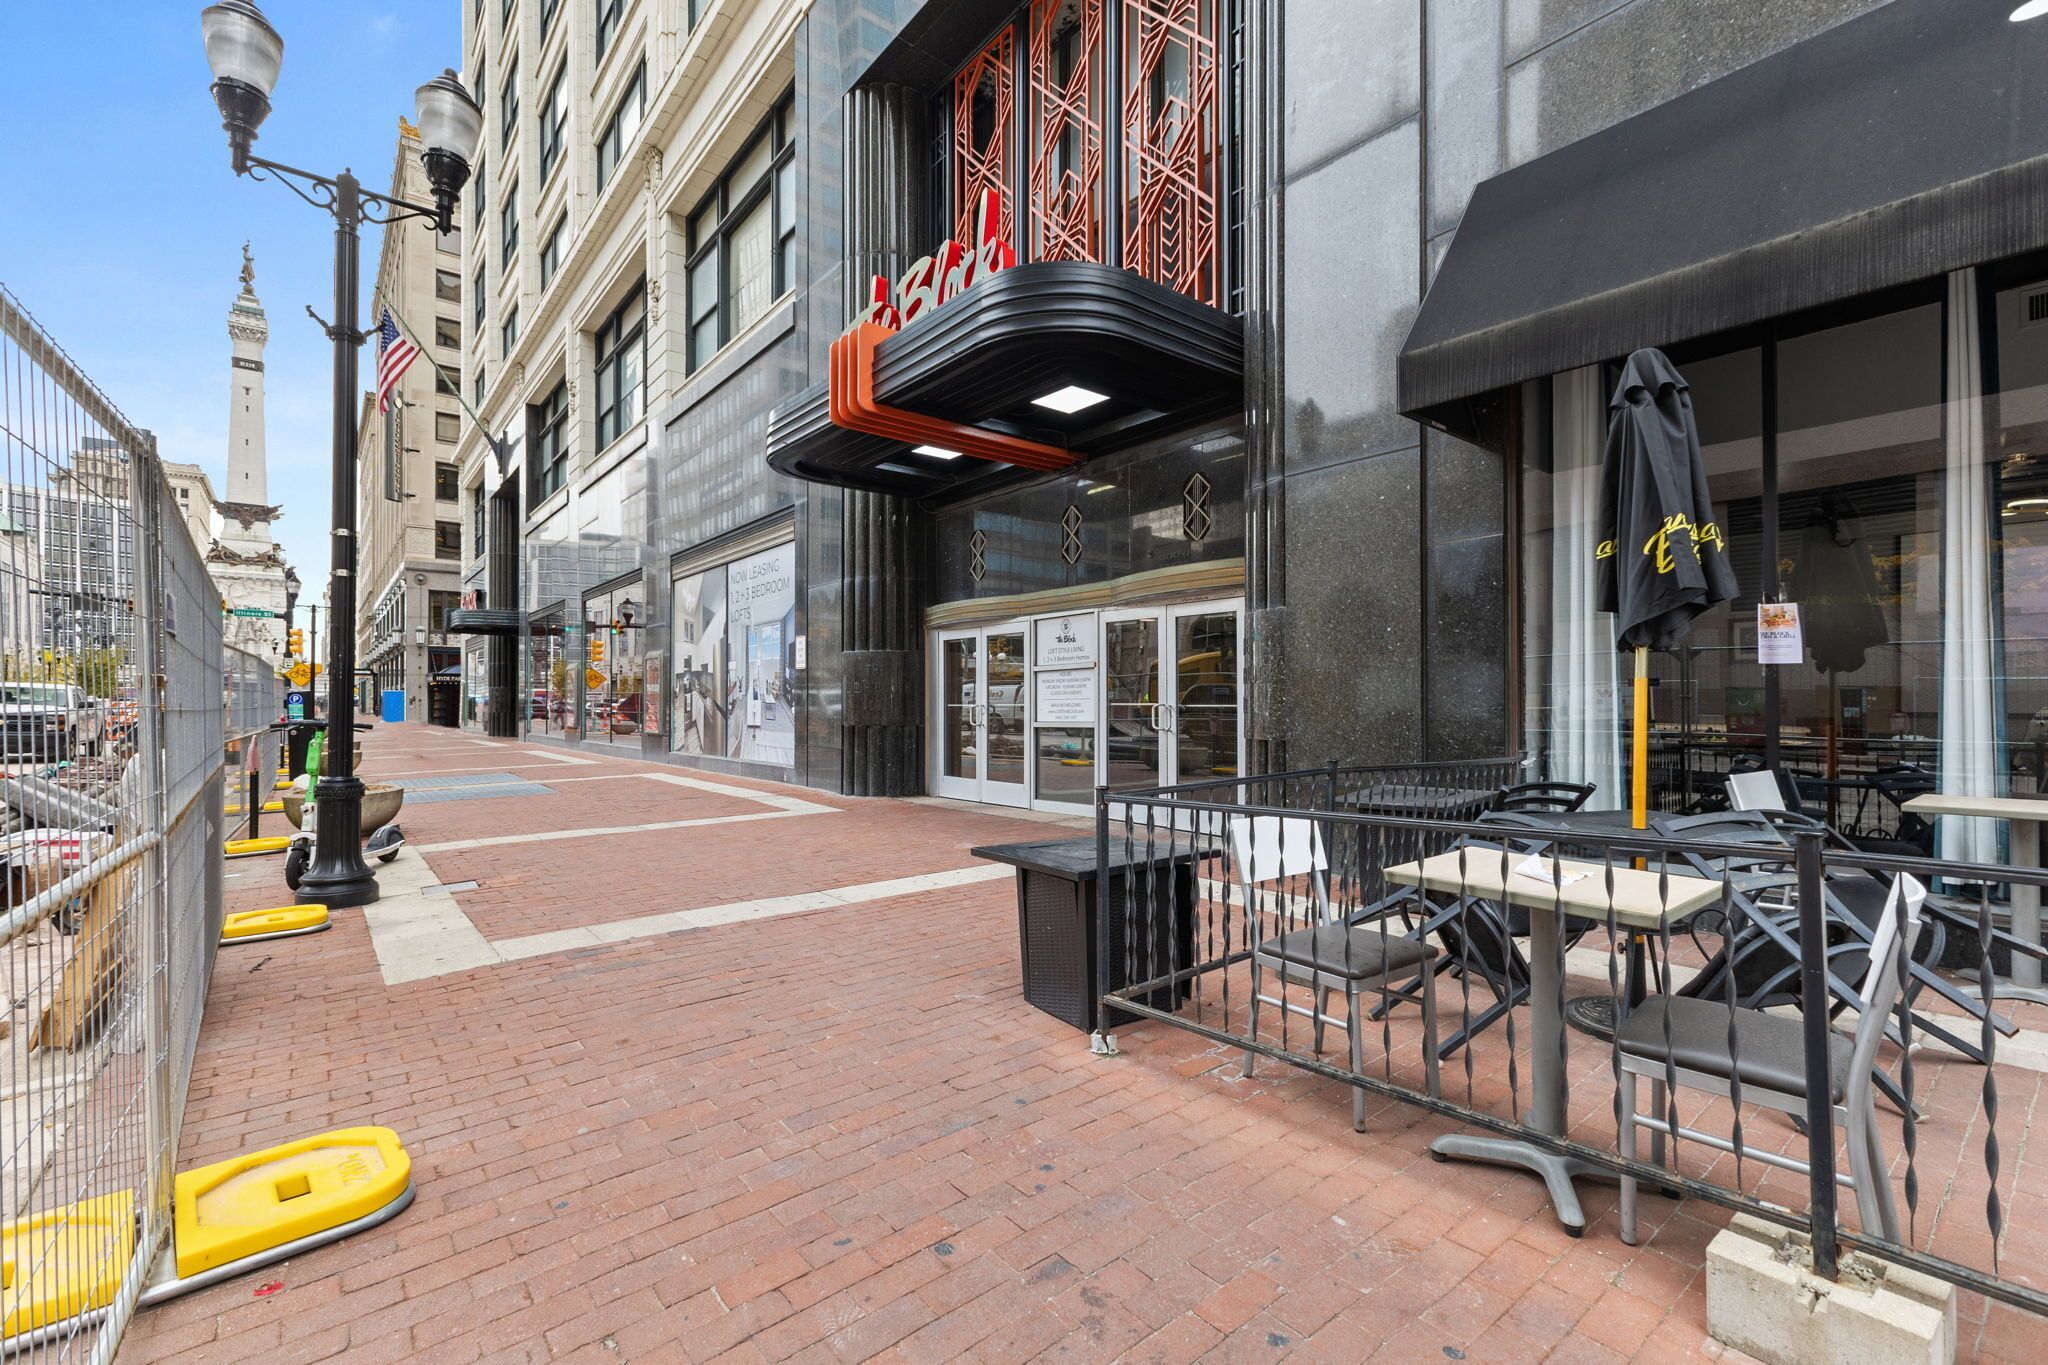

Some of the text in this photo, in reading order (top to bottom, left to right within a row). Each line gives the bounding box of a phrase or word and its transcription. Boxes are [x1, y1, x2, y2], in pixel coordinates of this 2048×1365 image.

[896, 187, 1015, 328] Block
[730, 559, 779, 584] NOW LEASING
[745, 587, 750, 601] 3
[751, 576, 790, 599] BEDROOM
[730, 606, 751, 623] LOFTS
